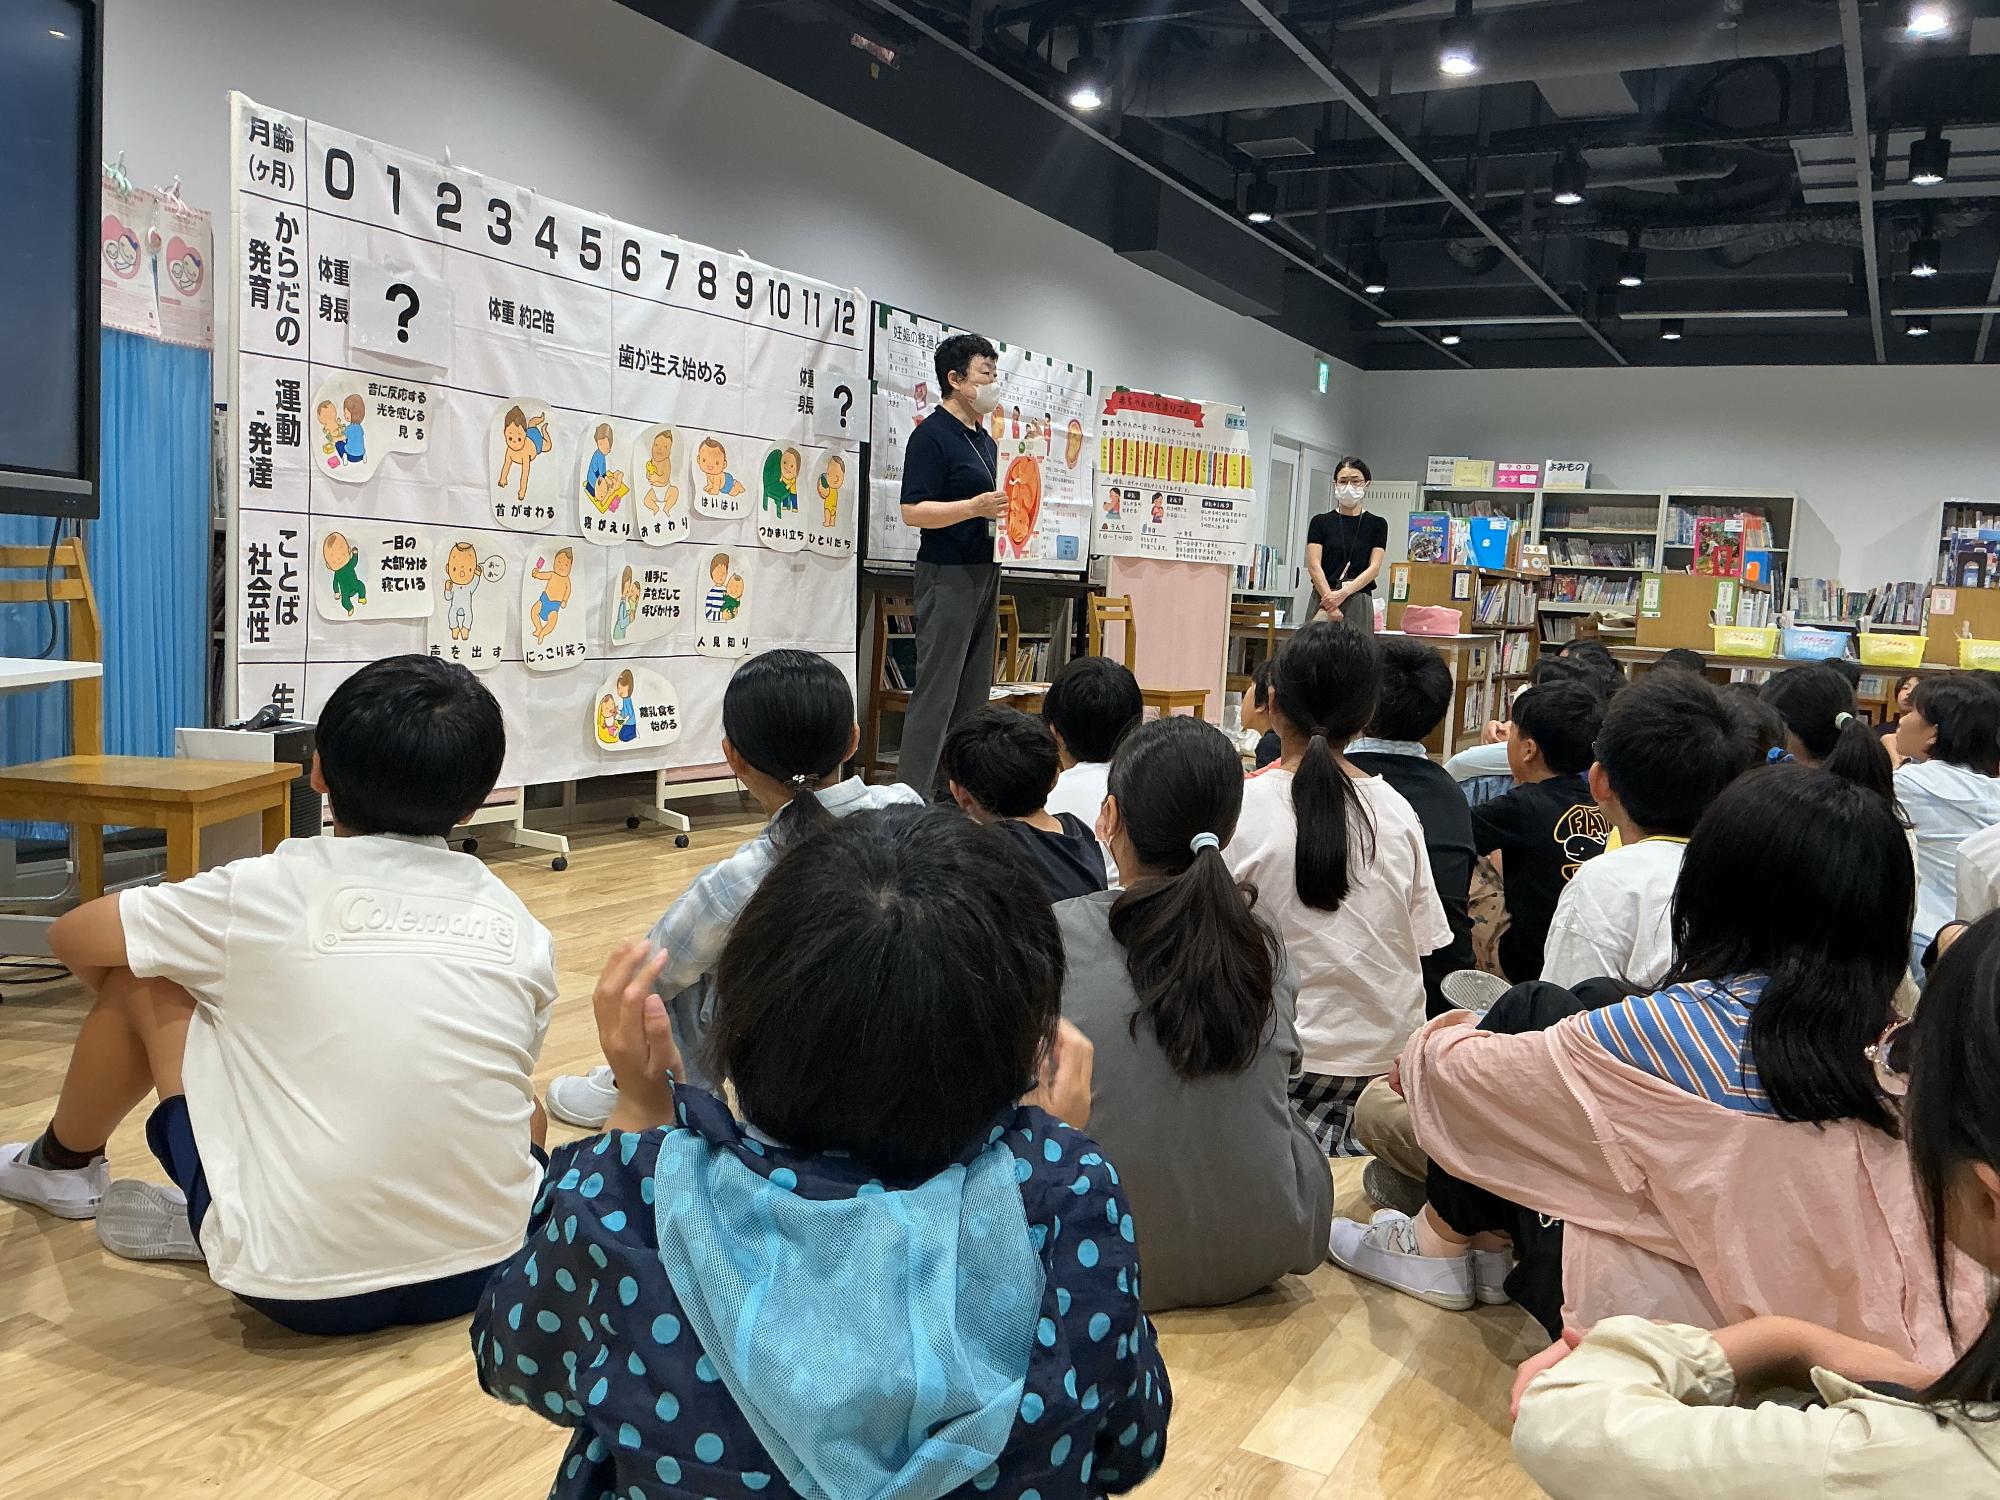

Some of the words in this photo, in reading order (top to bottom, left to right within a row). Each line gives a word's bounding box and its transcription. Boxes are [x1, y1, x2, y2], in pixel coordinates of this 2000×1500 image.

[249, 117, 295, 154] 月齢
[325, 148, 355, 200] 0
[386, 165, 401, 215] 1
[437, 182, 462, 233] 2
[487, 199, 512, 246] 3
[535, 215, 559, 260] 4
[579, 226, 601, 271] 5
[621, 239, 641, 282] 6
[660, 250, 680, 290] 7
[698, 260, 717, 301] 8
[735, 271, 753, 310] 9
[768, 279, 790, 319] 10
[802, 289, 821, 328] 11
[834, 297, 855, 336] 12
[248, 238, 272, 310] 発育
[275, 211, 301, 347] からだの
[318, 254, 350, 287] 体重
[318, 294, 349, 325] 身長
[384, 282, 420, 344] ?
[488, 295, 516, 326] 体重
[518, 303, 555, 335] 約2倍
[618, 343, 727, 386] 歯が生え始める
[368, 382, 427, 404] 音に反応する
[275, 378, 302, 448] 運動
[376, 402, 426, 423] 光を感じる
[834, 384, 853, 428] ?
[398, 424, 425, 441] 見る
[1548, 463, 1585, 472] よみもの
[1498, 475, 1518, 483] 文学
[495, 503, 556, 520] 首がすわる
[701, 495, 739, 511] はいはい
[584, 515, 630, 536] 寝がえり
[641, 516, 688, 538] おすわり
[759, 526, 805, 541] つかまり立ち
[382, 535, 417, 550] 一日の
[808, 532, 851, 550] ひとりだち
[381, 555, 428, 571] 大部分は
[276, 529, 301, 626] ことば
[381, 576, 426, 593] 寝ている
[644, 570, 668, 583] 相手に
[247, 542, 273, 644] 社会性
[643, 586, 681, 601] 声をだして
[642, 605, 680, 618] 呼びかける
[430, 644, 502, 659] 声を出す
[526, 642, 587, 664] にっこり笑う
[697, 636, 749, 649] 人見知り
[639, 704, 676, 719] 離乳食を
[650, 719, 678, 733] 始める
[339, 895, 485, 940] Coleman
